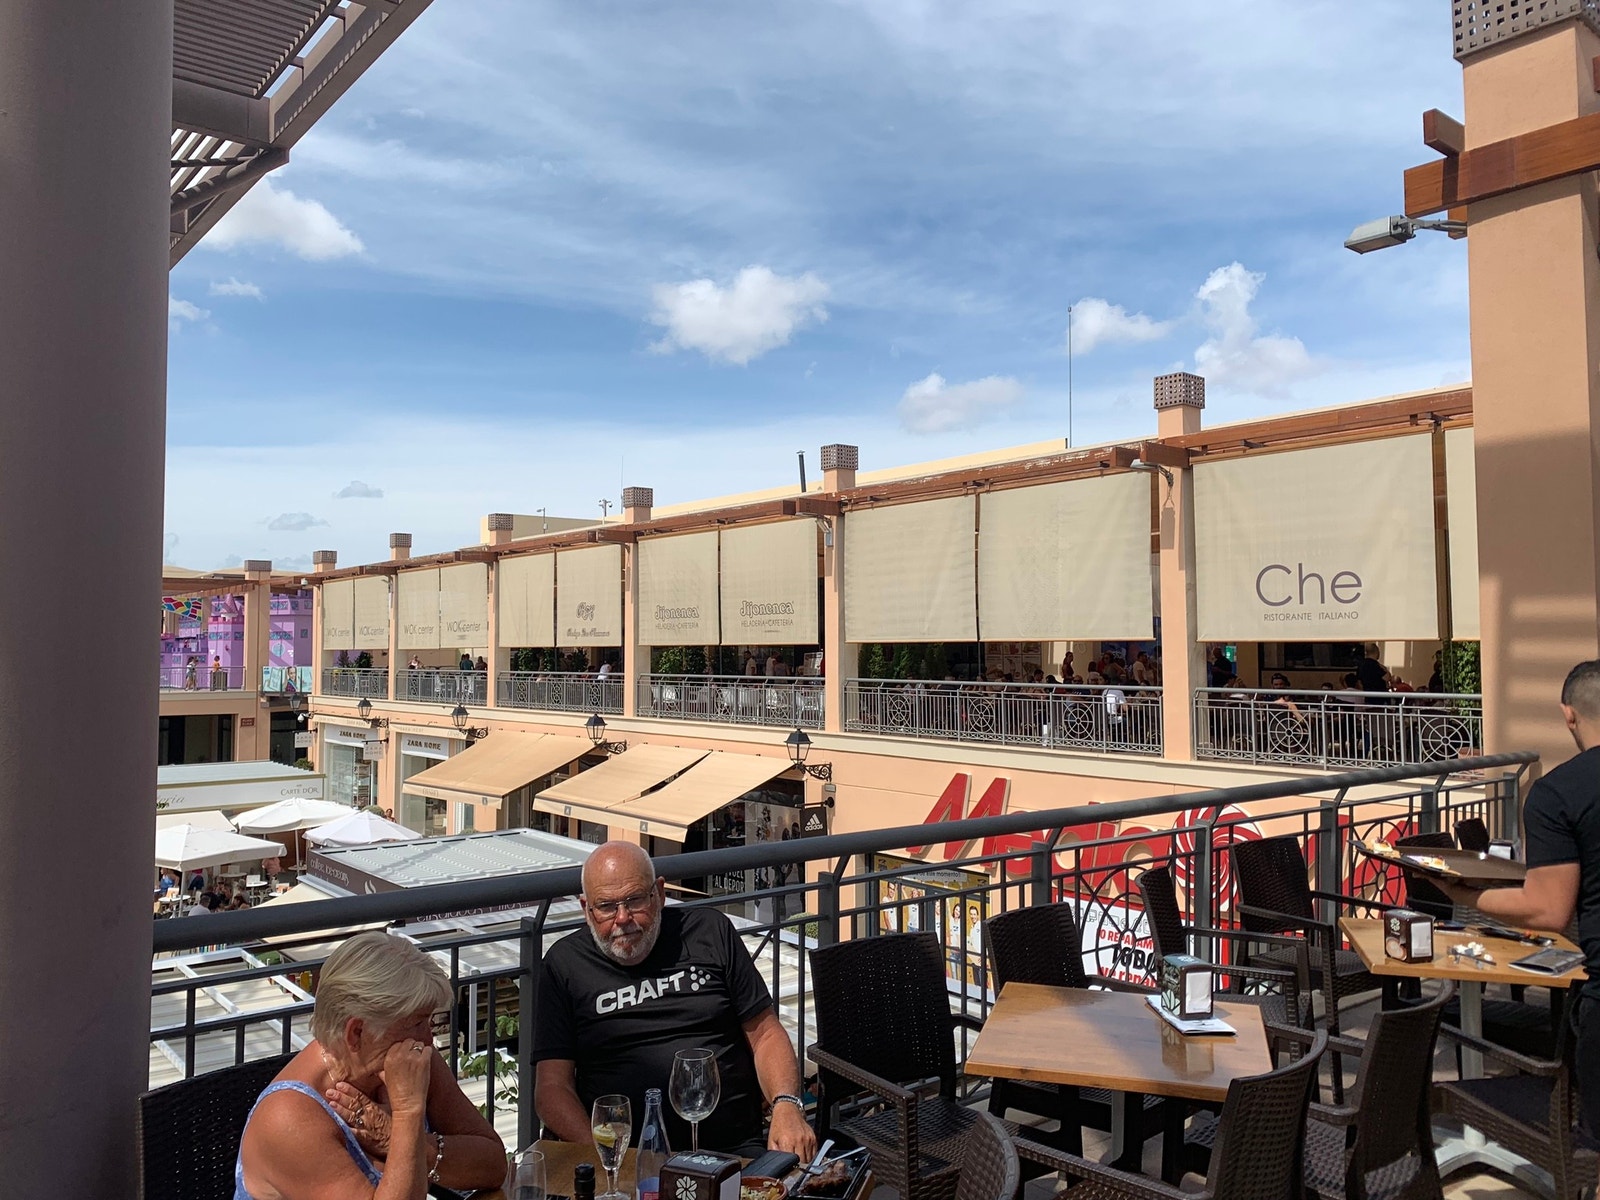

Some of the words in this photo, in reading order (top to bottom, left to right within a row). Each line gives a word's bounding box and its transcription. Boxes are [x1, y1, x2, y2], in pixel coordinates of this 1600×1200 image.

[1255, 562, 1363, 607] Che
[654, 604, 700, 621] Jijonenca
[739, 600, 795, 618] Jijonenca
[1263, 612, 1312, 622] RISTORANTE
[1318, 610, 1359, 620] ITALIANO
[403, 624, 417, 636] WOK
[446, 621, 462, 634] WOK
[339, 730, 352, 738] ZARA
[353, 732, 366, 740] HOME
[407, 739, 422, 748] ZARA
[423, 742, 441, 751] HOME
[804, 821, 824, 832] adidas
[595, 970, 685, 1015] CRAFT
